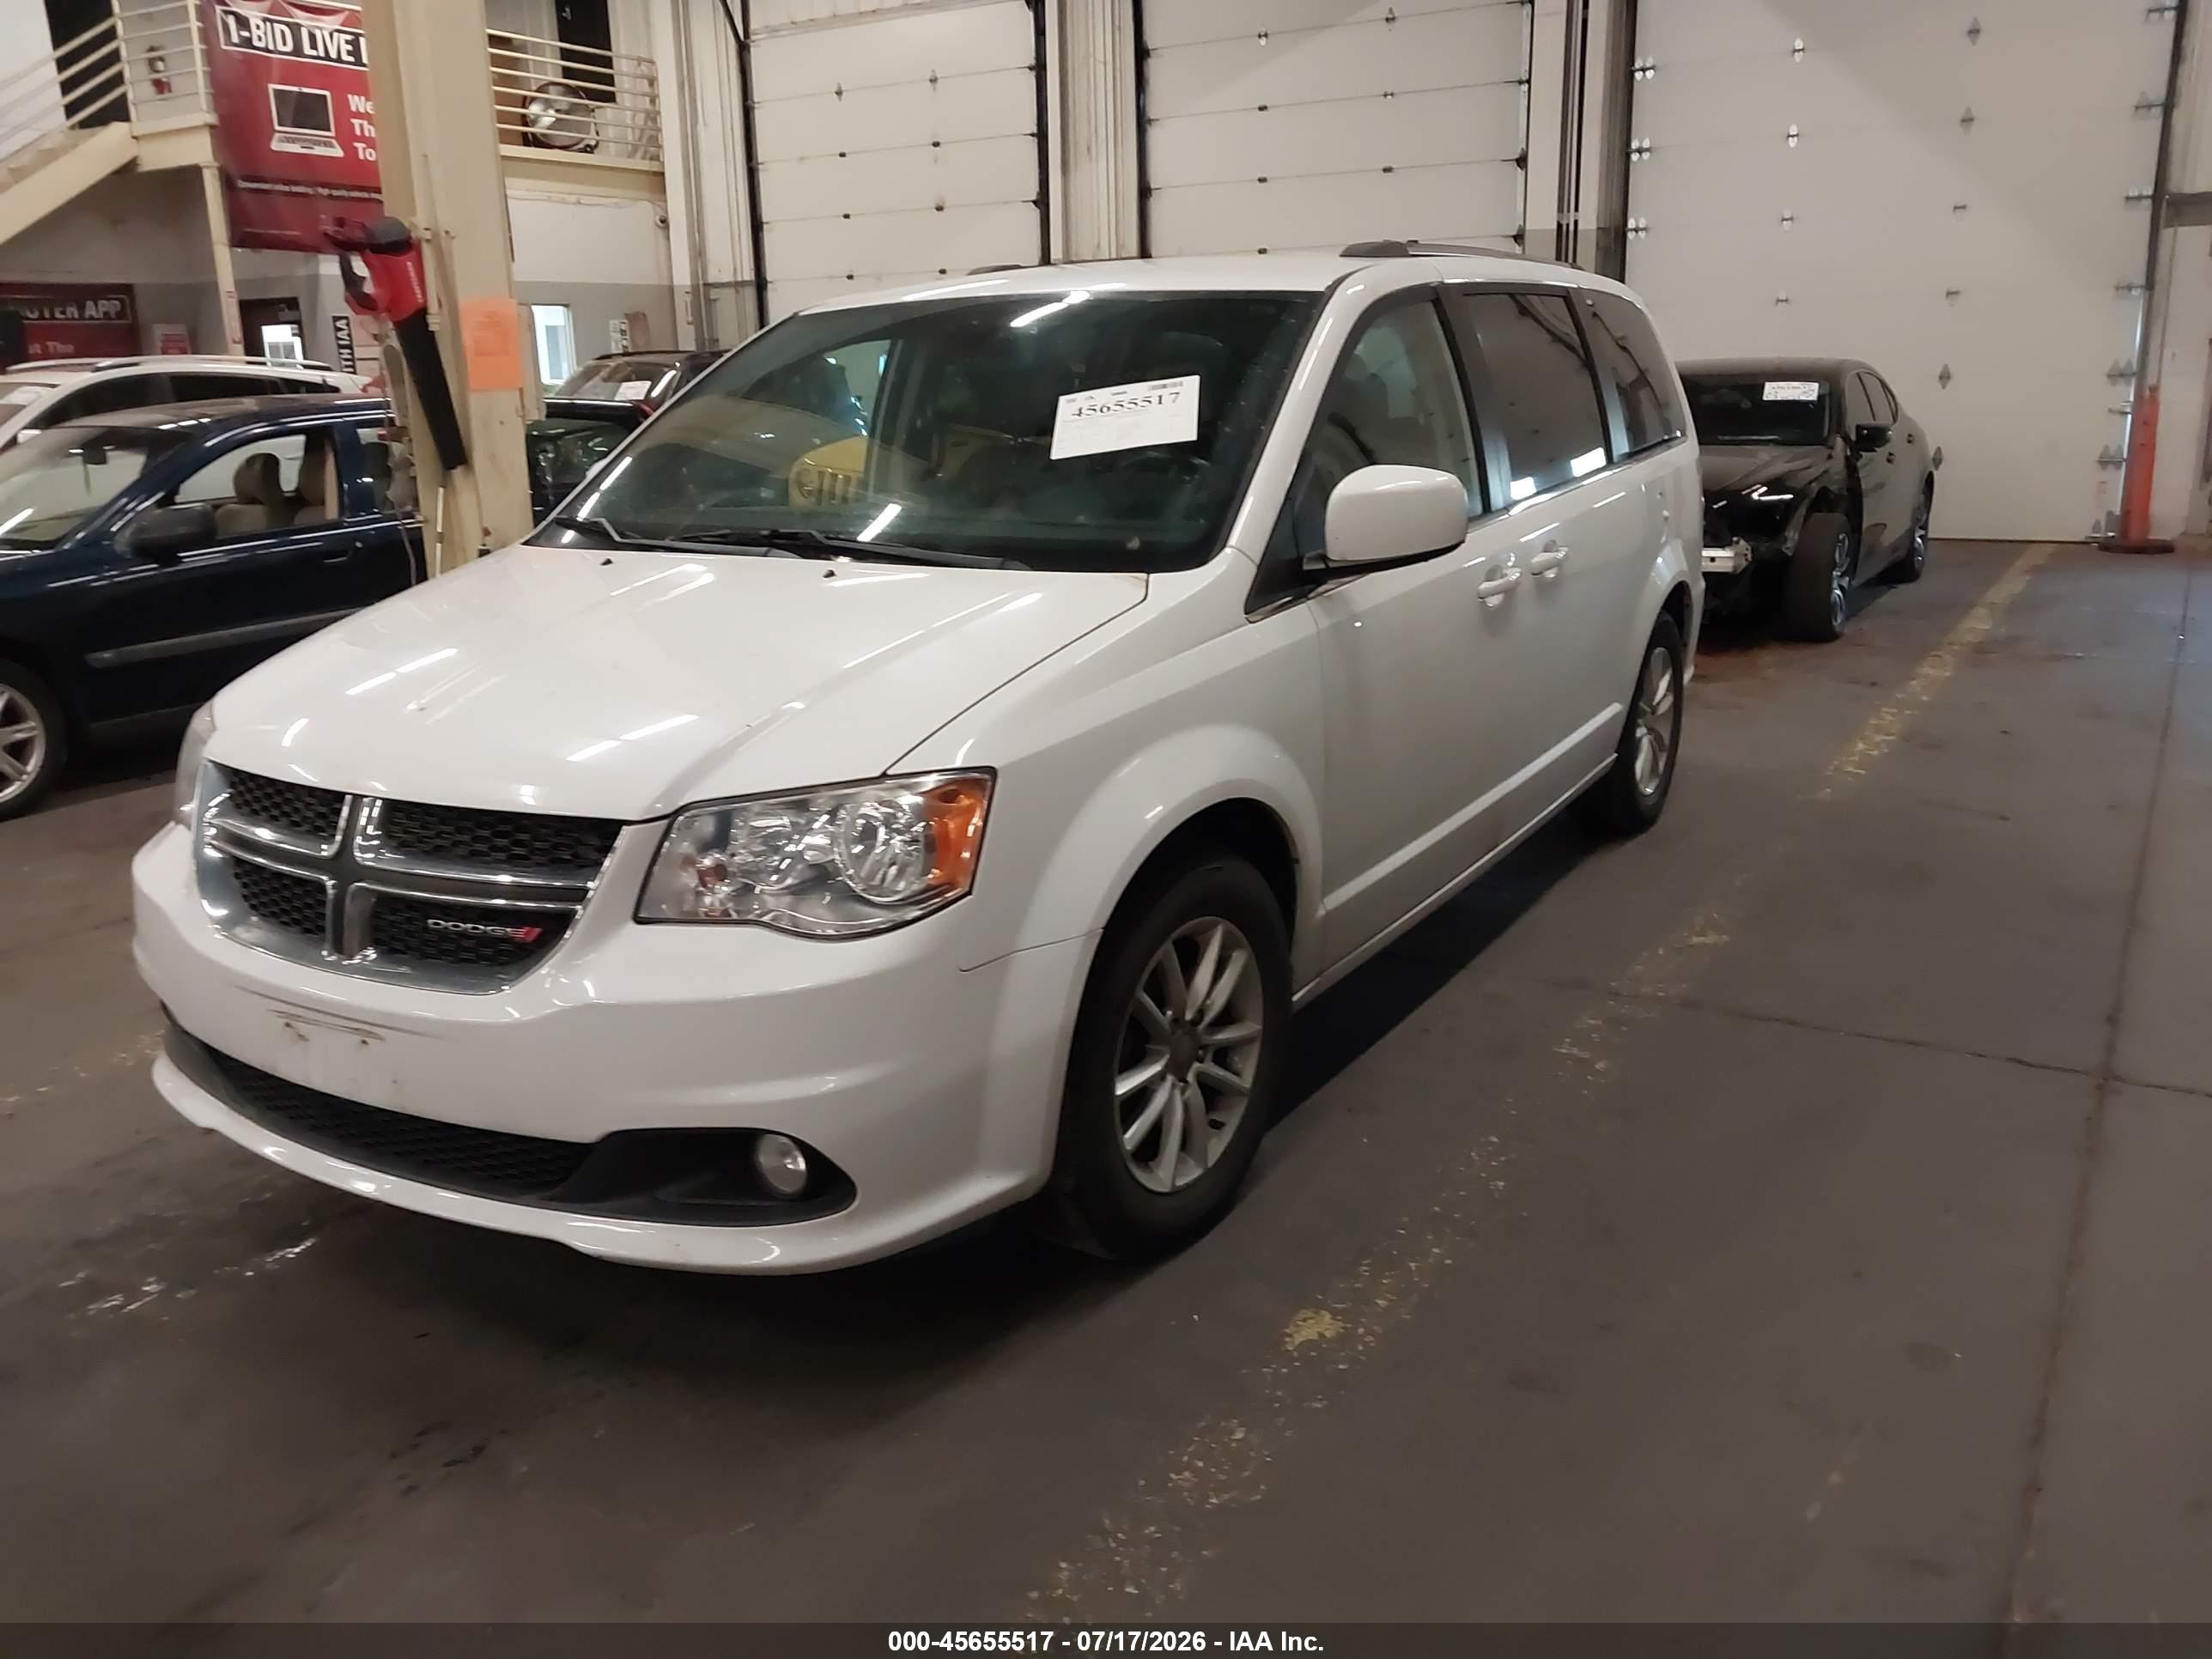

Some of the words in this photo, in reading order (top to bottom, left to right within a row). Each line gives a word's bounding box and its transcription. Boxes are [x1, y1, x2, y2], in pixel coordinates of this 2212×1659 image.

[227, 15, 294, 52] 1-BID
[301, 27, 356, 63] LIVE
[352, 142, 377, 161] To
[84, 300, 122, 319] APP
[335, 319, 352, 345] IAA
[1072, 392, 1181, 418] 45655517
[427, 919, 526, 941] DODGE
